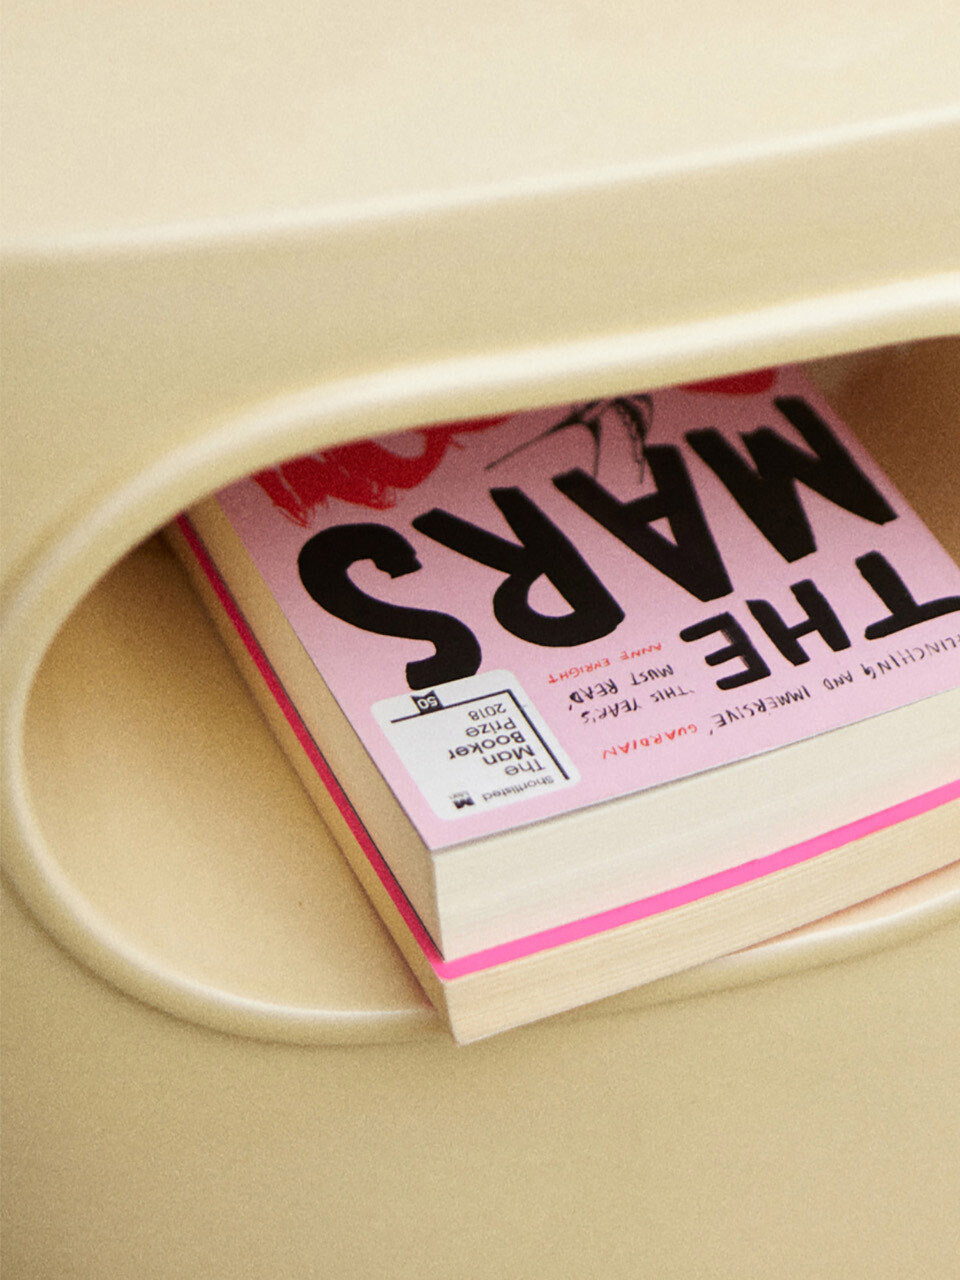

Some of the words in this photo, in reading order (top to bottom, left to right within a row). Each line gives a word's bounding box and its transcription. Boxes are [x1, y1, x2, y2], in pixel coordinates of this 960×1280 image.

[297, 394, 898, 691] MARS
[620, 642, 662, 661] ANNE
[548, 657, 611, 684] ENRIGHT
[630, 664, 674, 686] MUST
[822, 670, 854, 690] AND
[417, 695, 438, 709] 50
[468, 703, 507, 721] 2018
[580, 697, 643, 724] YEAR'S
[465, 716, 517, 738] Prize
[448, 730, 526, 760] Booker
[602, 723, 698, 760] GUARDIAN
[482, 744, 535, 766] Man
[505, 757, 546, 776] The
[482, 775, 555, 802] Shortlisted
